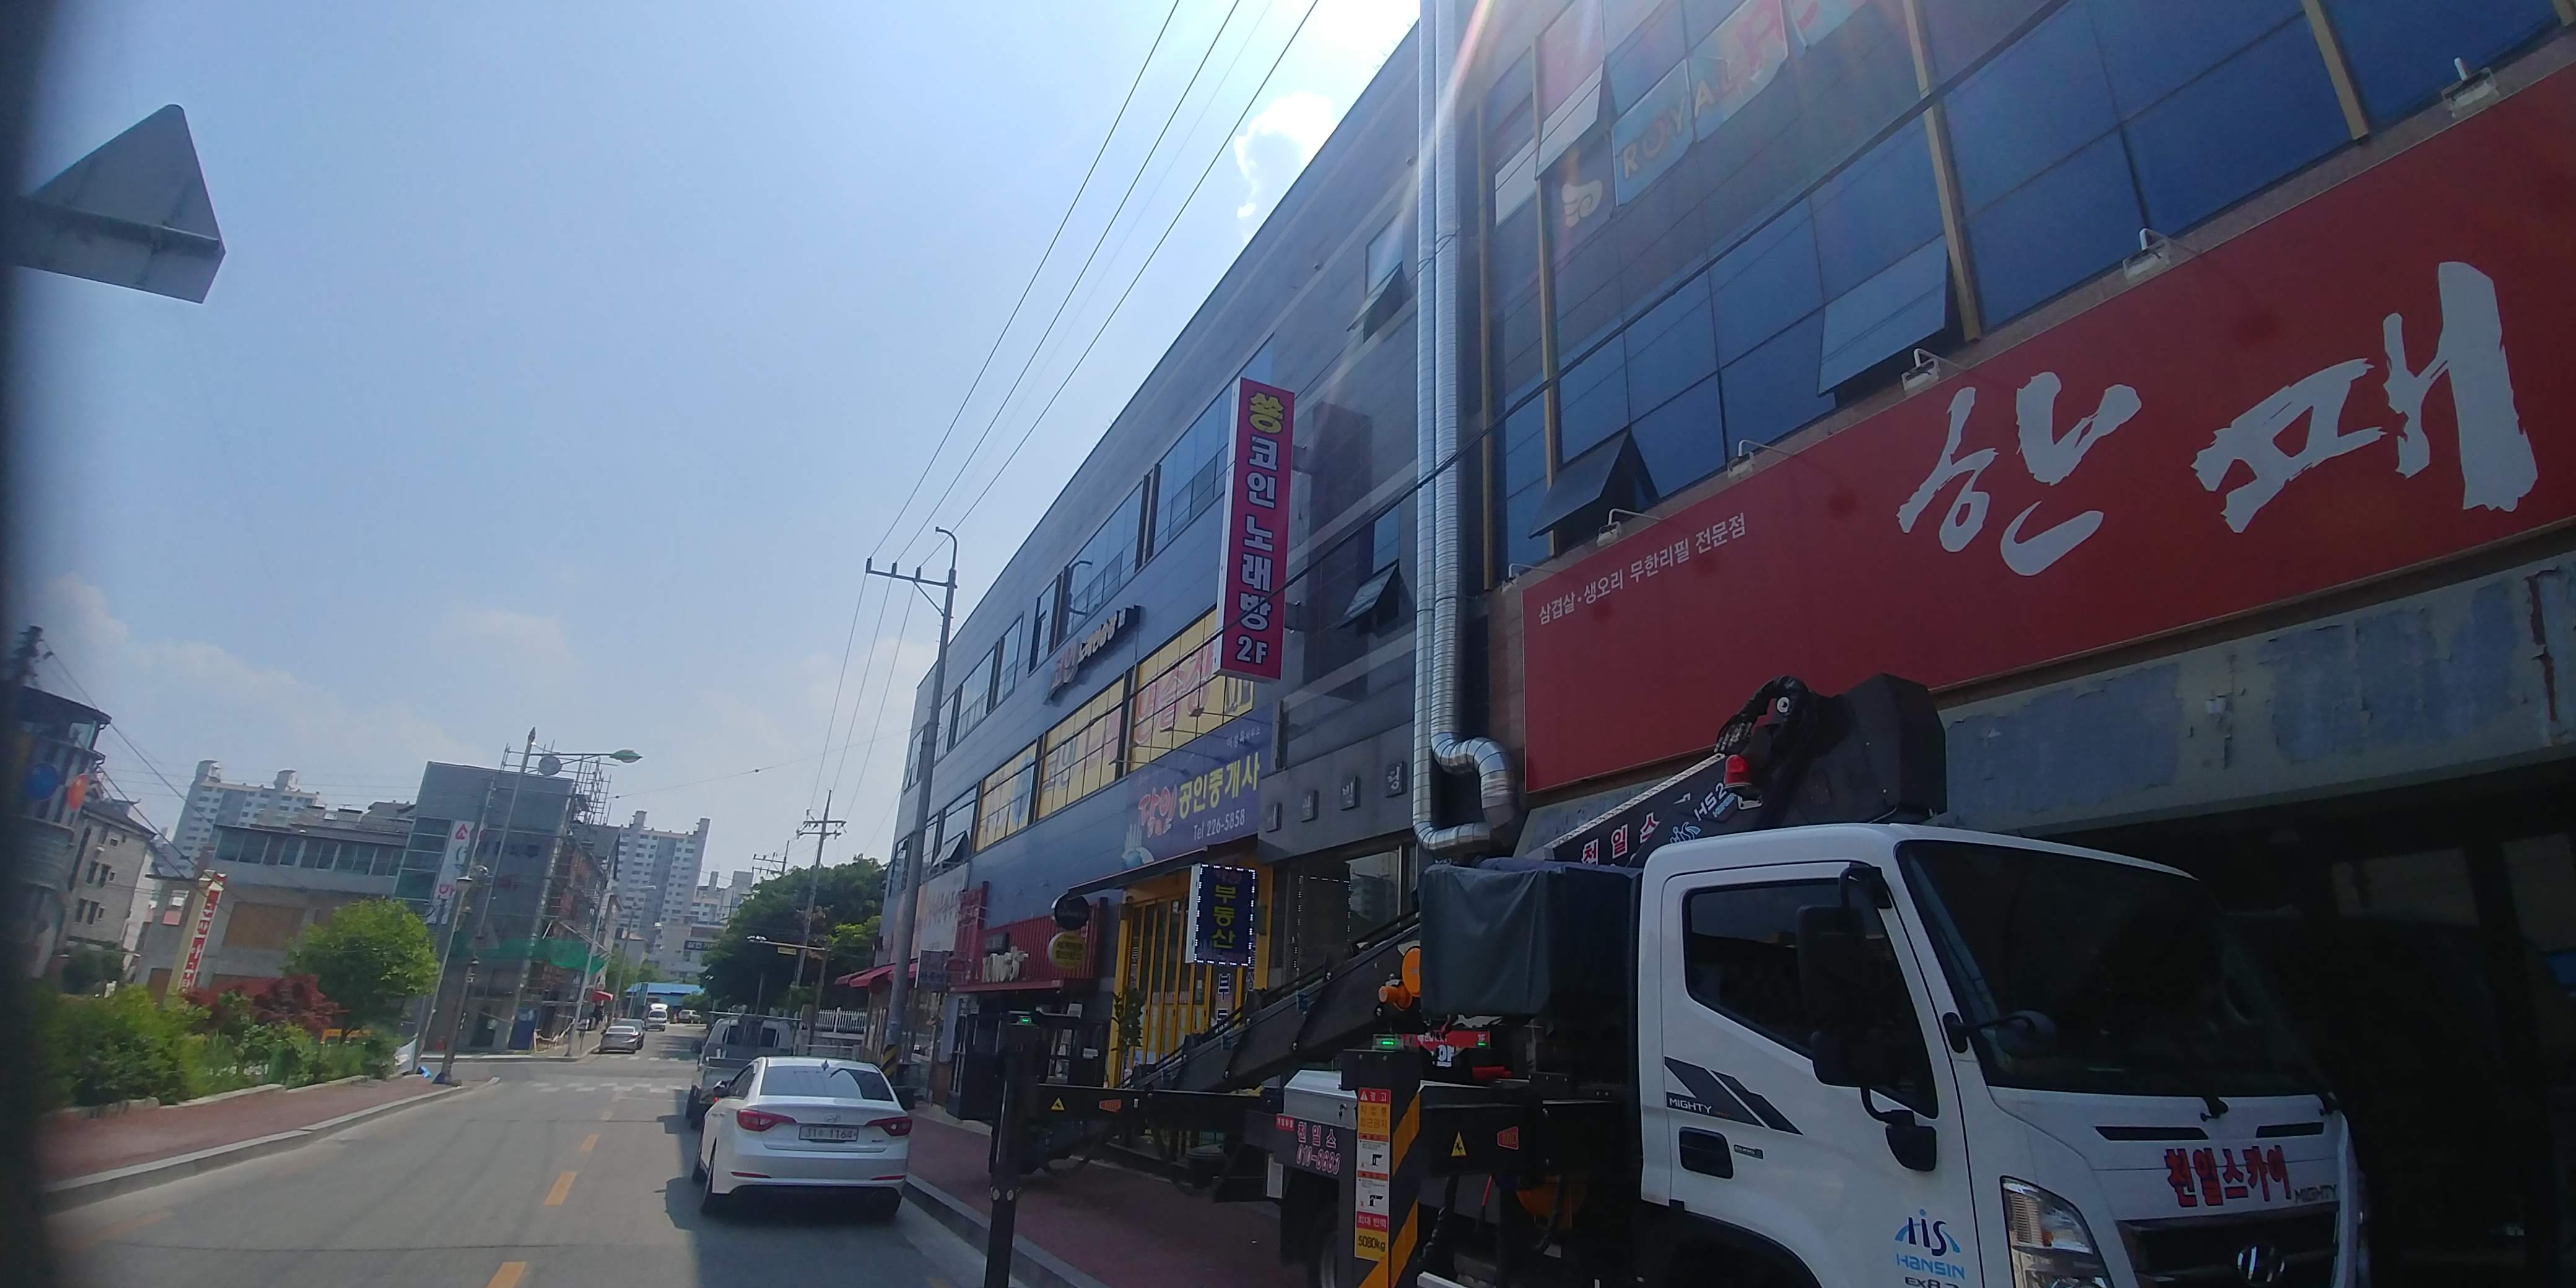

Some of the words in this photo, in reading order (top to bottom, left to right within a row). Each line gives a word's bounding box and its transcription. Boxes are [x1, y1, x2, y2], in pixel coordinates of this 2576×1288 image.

[1245, 435, 1279, 510] 코인
[1239, 514, 1274, 633] 노래방
[1630, 539, 1689, 583] 무한리필
[1695, 512, 1746, 555] 전문점
[1235, 634, 1268, 666] 2F
[1178, 752, 1260, 819] 공인중개사
[1193, 822, 1204, 842] Tel
[1206, 808, 1245, 837] 226-5858
[1212, 884, 1237, 949] 부동산
[1669, 1097, 1712, 1115] MIGHTY
[2164, 1145, 2292, 1208] 천일스카이
[2294, 1184, 2337, 1203] MIGHTY
[1358, 1235, 1386, 1252] 5080kg
